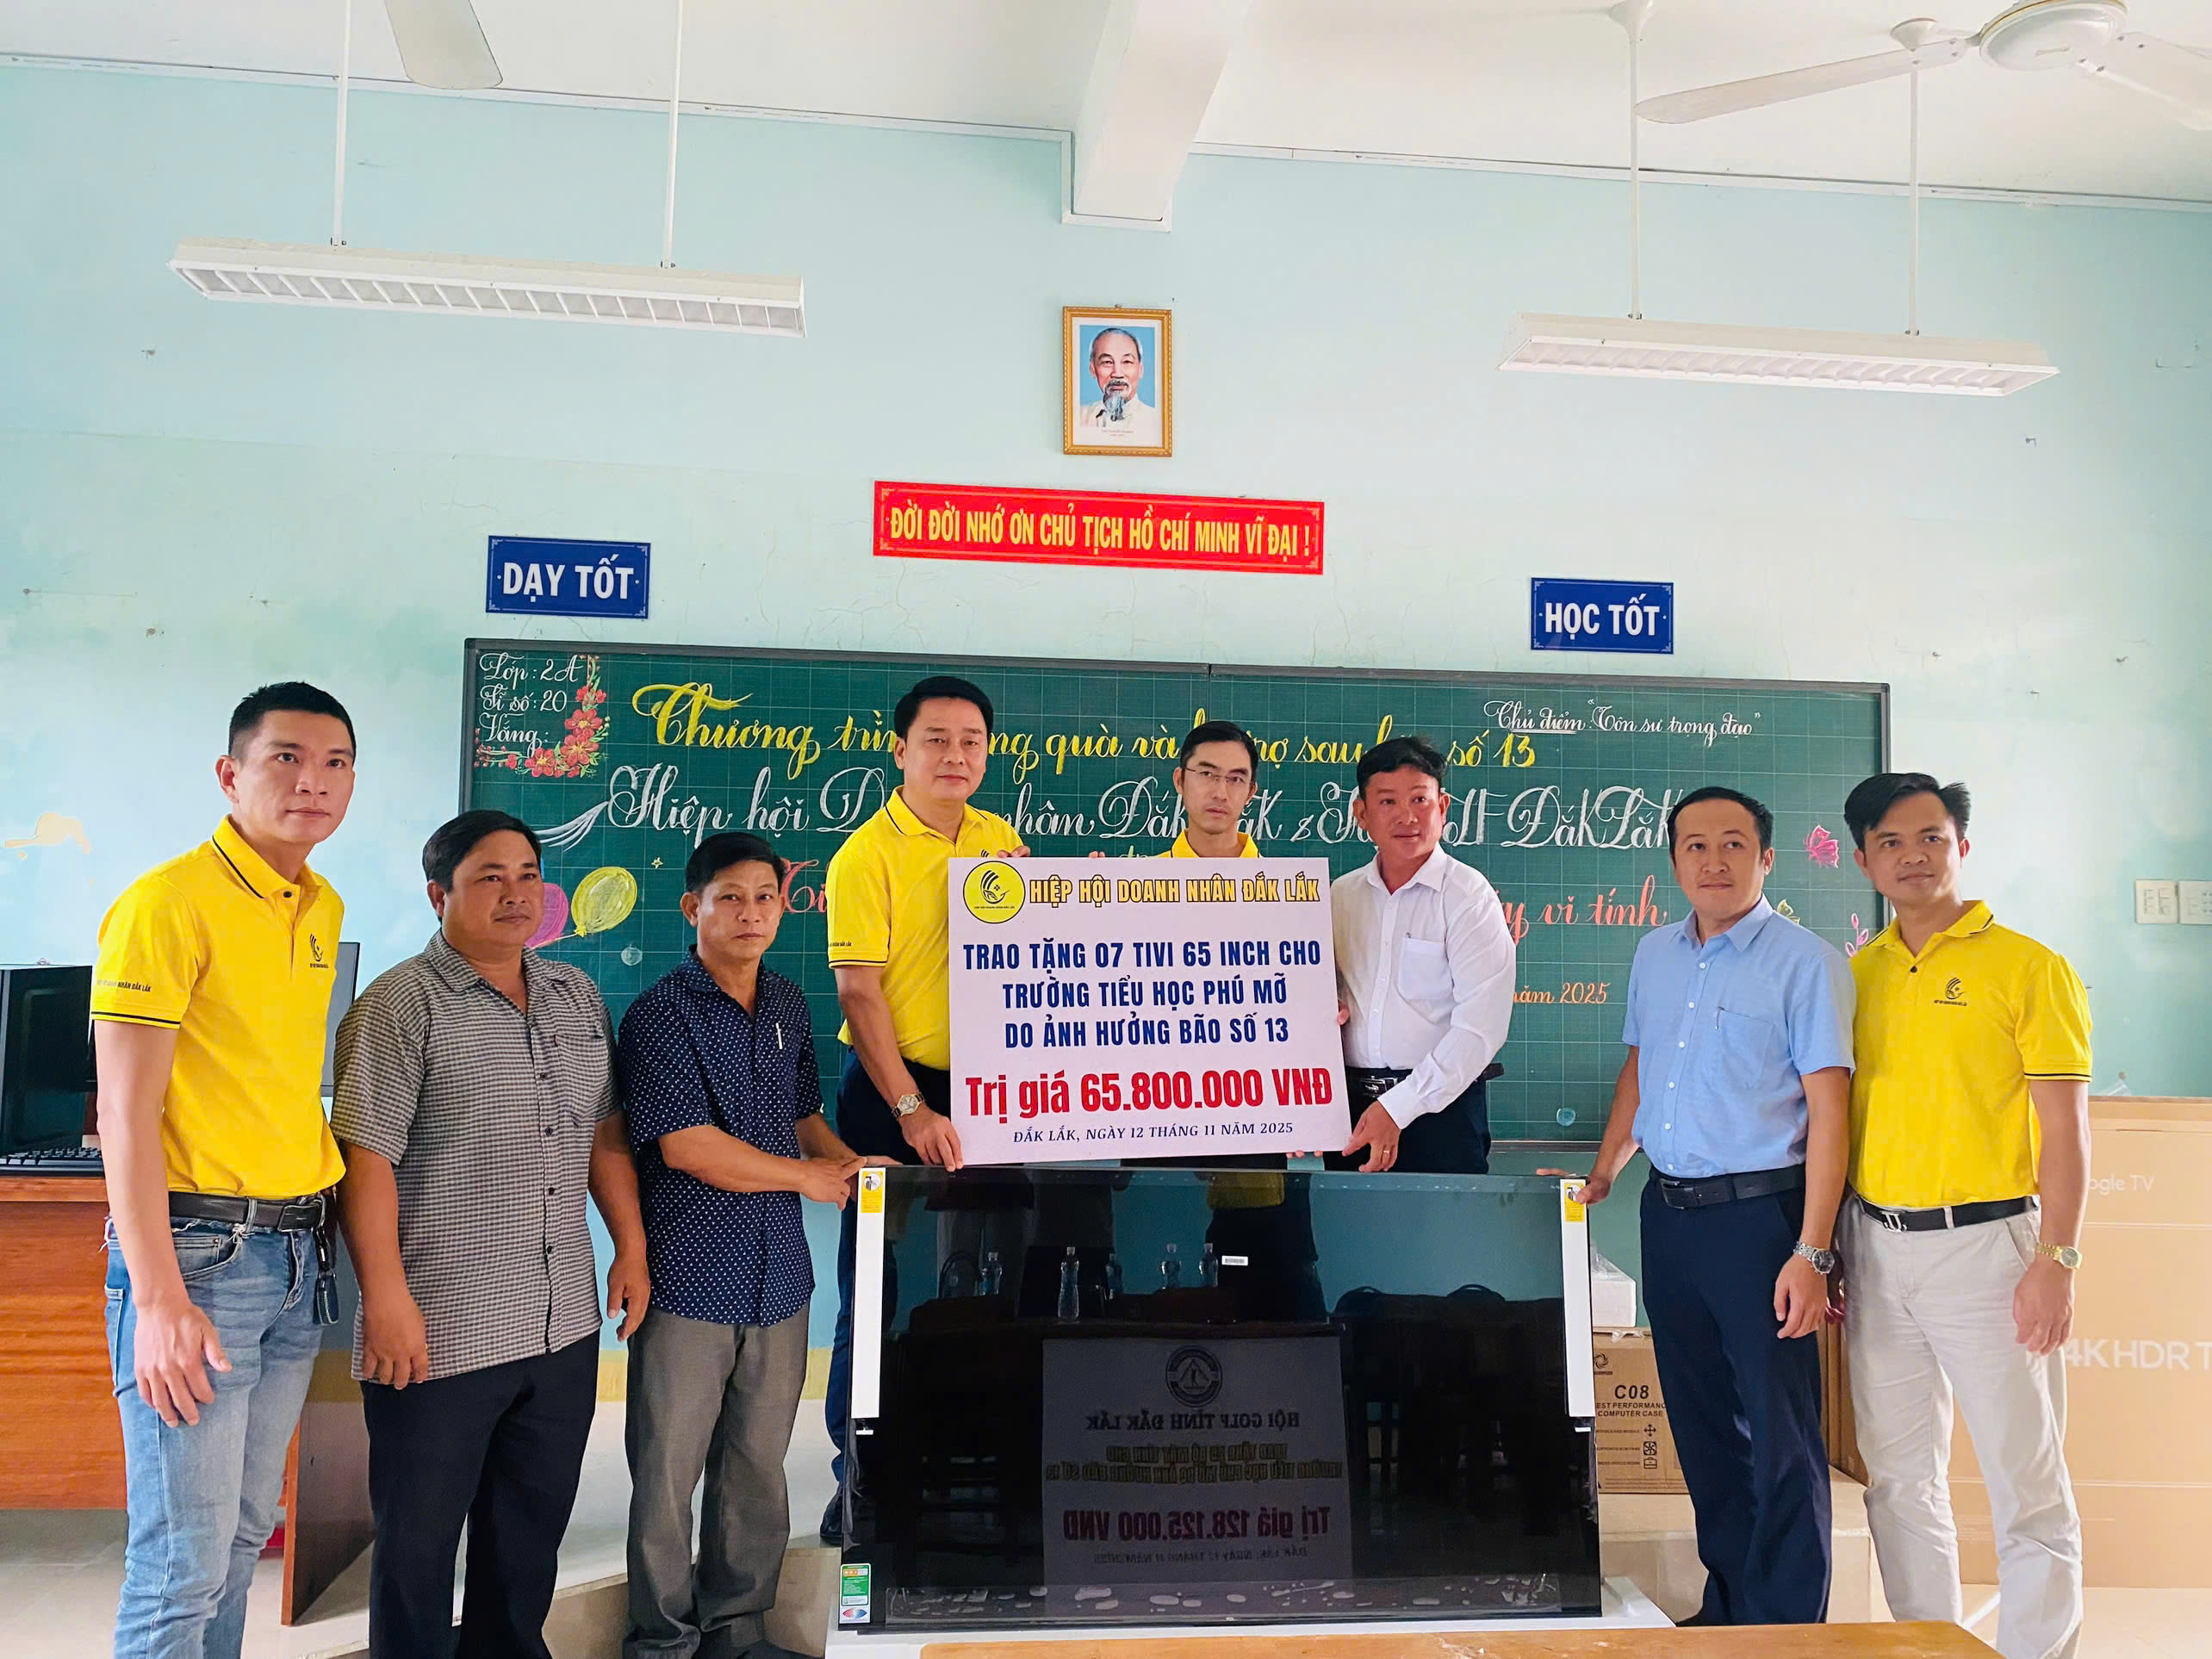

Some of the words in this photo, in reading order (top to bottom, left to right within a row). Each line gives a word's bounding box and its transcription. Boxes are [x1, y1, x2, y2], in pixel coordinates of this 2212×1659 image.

[890, 499, 923, 541] ĐỜI
[928, 500, 960, 542] ĐỜI
[966, 503, 1005, 544] NHỚ
[1010, 507, 1035, 545] ƠN
[1040, 502, 1076, 547] CHỦ
[1082, 515, 1123, 556] TỊCH
[1129, 504, 1154, 550] HỒ
[1159, 512, 1190, 551] CHÍ
[1195, 520, 1240, 554] MINH
[1246, 515, 1264, 555] VĨ
[1267, 524, 1298, 562] ĐẠI
[503, 562, 544, 603] DẠY
[575, 554, 635, 600] TỐT
[1545, 602, 1600, 641] HỌC
[1608, 593, 1661, 636] TỐT
[540, 655, 584, 682] 2A
[539, 690, 568, 712] 20
[632, 681, 821, 780] Chương
[1046, 724, 1122, 774] quà
[1131, 724, 1180, 759] và
[1295, 736, 1366, 764] sau
[1446, 730, 1490, 767] số
[1493, 733, 1536, 767] 13
[1483, 700, 1536, 730] Chủ
[1638, 718, 1663, 732] sư
[1667, 716, 1718, 748] trọng
[607, 762, 733, 849] Hiệp
[741, 766, 810, 838] hội
[1029, 874, 1073, 908] HIỆP
[1078, 874, 1111, 908] HỘI
[1117, 879, 1180, 904] DOANH
[1186, 873, 1236, 903] NHÂN
[1241, 872, 1279, 903] ĐẮK
[1285, 872, 1320, 903] LẮK
[1537, 896, 1579, 925] vi
[1585, 874, 1668, 927] tính
[963, 943, 1020, 970] TRAO
[1028, 938, 1086, 974] TẶNG
[1095, 942, 1124, 967] 07
[1133, 941, 1173, 967] TIVI
[1183, 941, 1211, 966] 65
[1221, 941, 1270, 966] INCH
[1279, 941, 1321, 966] CHO
[1003, 976, 1090, 1009] TRƯỜNG
[1098, 974, 1144, 1008] TIỂU
[1153, 981, 1195, 1012] HỌC
[1203, 974, 1245, 1005] PHÚ
[1253, 972, 1287, 1004] MỠ
[1560, 982, 1611, 1004] 2025
[1005, 1022, 1033, 1048] DO
[1043, 1014, 1086, 1047] ẢNH
[1096, 1011, 1171, 1047] HƯỞNG
[1179, 1016, 1221, 1044] BÃO
[1230, 1011, 1258, 1043] SỐ
[1264, 1017, 1289, 1042] 13
[966, 1074, 1008, 1124] Trị
[1019, 1069, 1070, 1120] giá
[1081, 1069, 1264, 1111] 65.800.000
[1272, 1067, 1333, 1106] VNĐ
[1013, 1126, 1044, 1143] ĐẮK
[1048, 1125, 1080, 1143] LẮK,
[1085, 1122, 1126, 1141] NGÀY
[1130, 1127, 1145, 1139] 12
[1149, 1121, 1199, 1138] THÁNG
[1204, 1126, 1215, 1136] 11
[1221, 1122, 1255, 1136] NĂM
[1260, 1122, 1294, 1134] 2025
[2087, 1173, 2126, 1196] ogle
[2129, 1174, 2154, 1192] TV
[2066, 1339, 2109, 1368] 4K
[2114, 1340, 2191, 1370] HDR
[1614, 1384, 1650, 1400] C08
